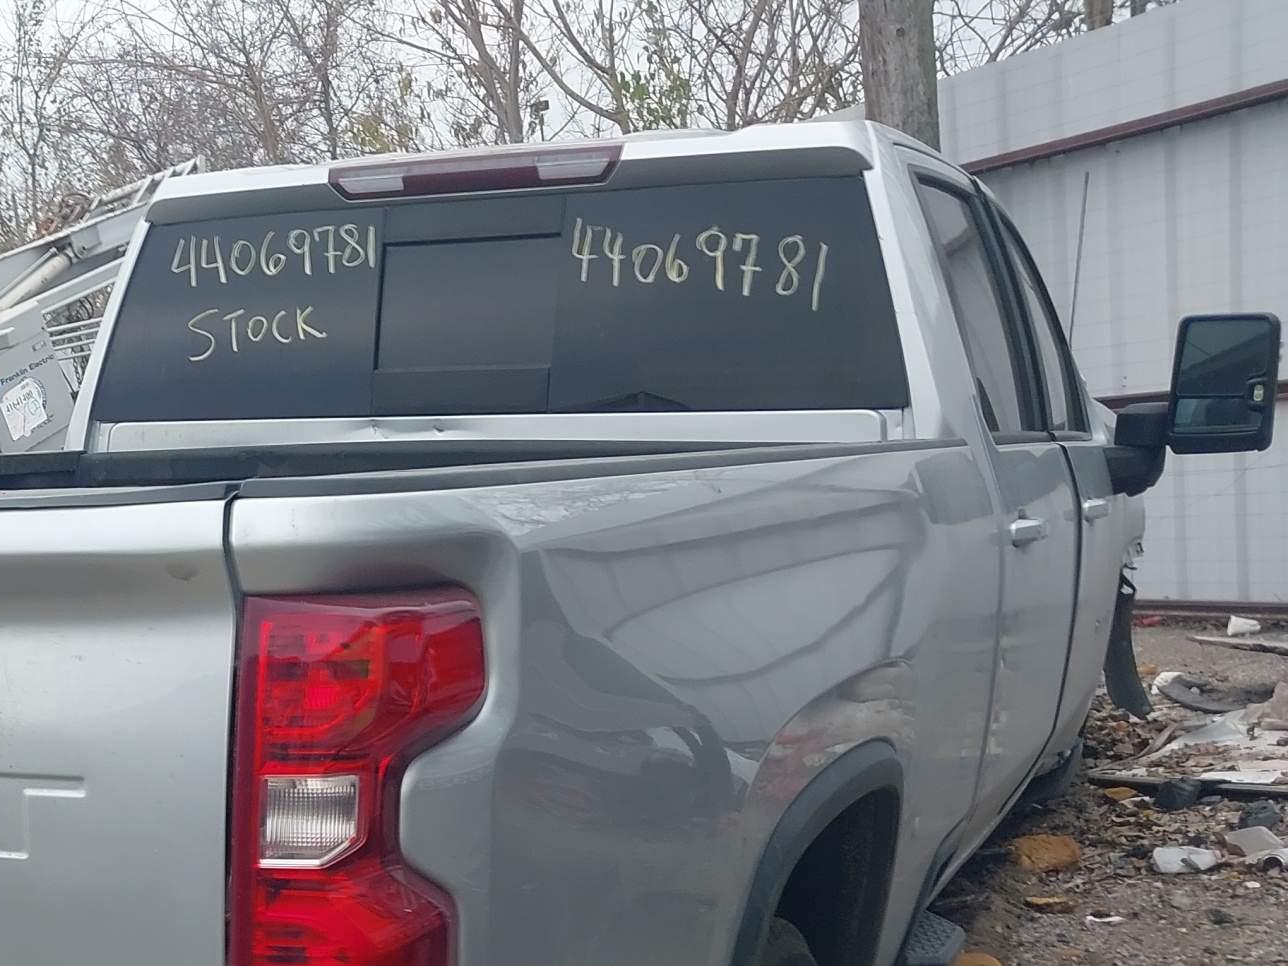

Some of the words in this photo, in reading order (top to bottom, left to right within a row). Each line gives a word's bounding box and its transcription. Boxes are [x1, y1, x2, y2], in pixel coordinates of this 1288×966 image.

[170, 223, 376, 288] 44069781
[571, 216, 829, 311] 44069781
[187, 305, 327, 362] STOCK
[0, 367, 29, 385] Franklin
